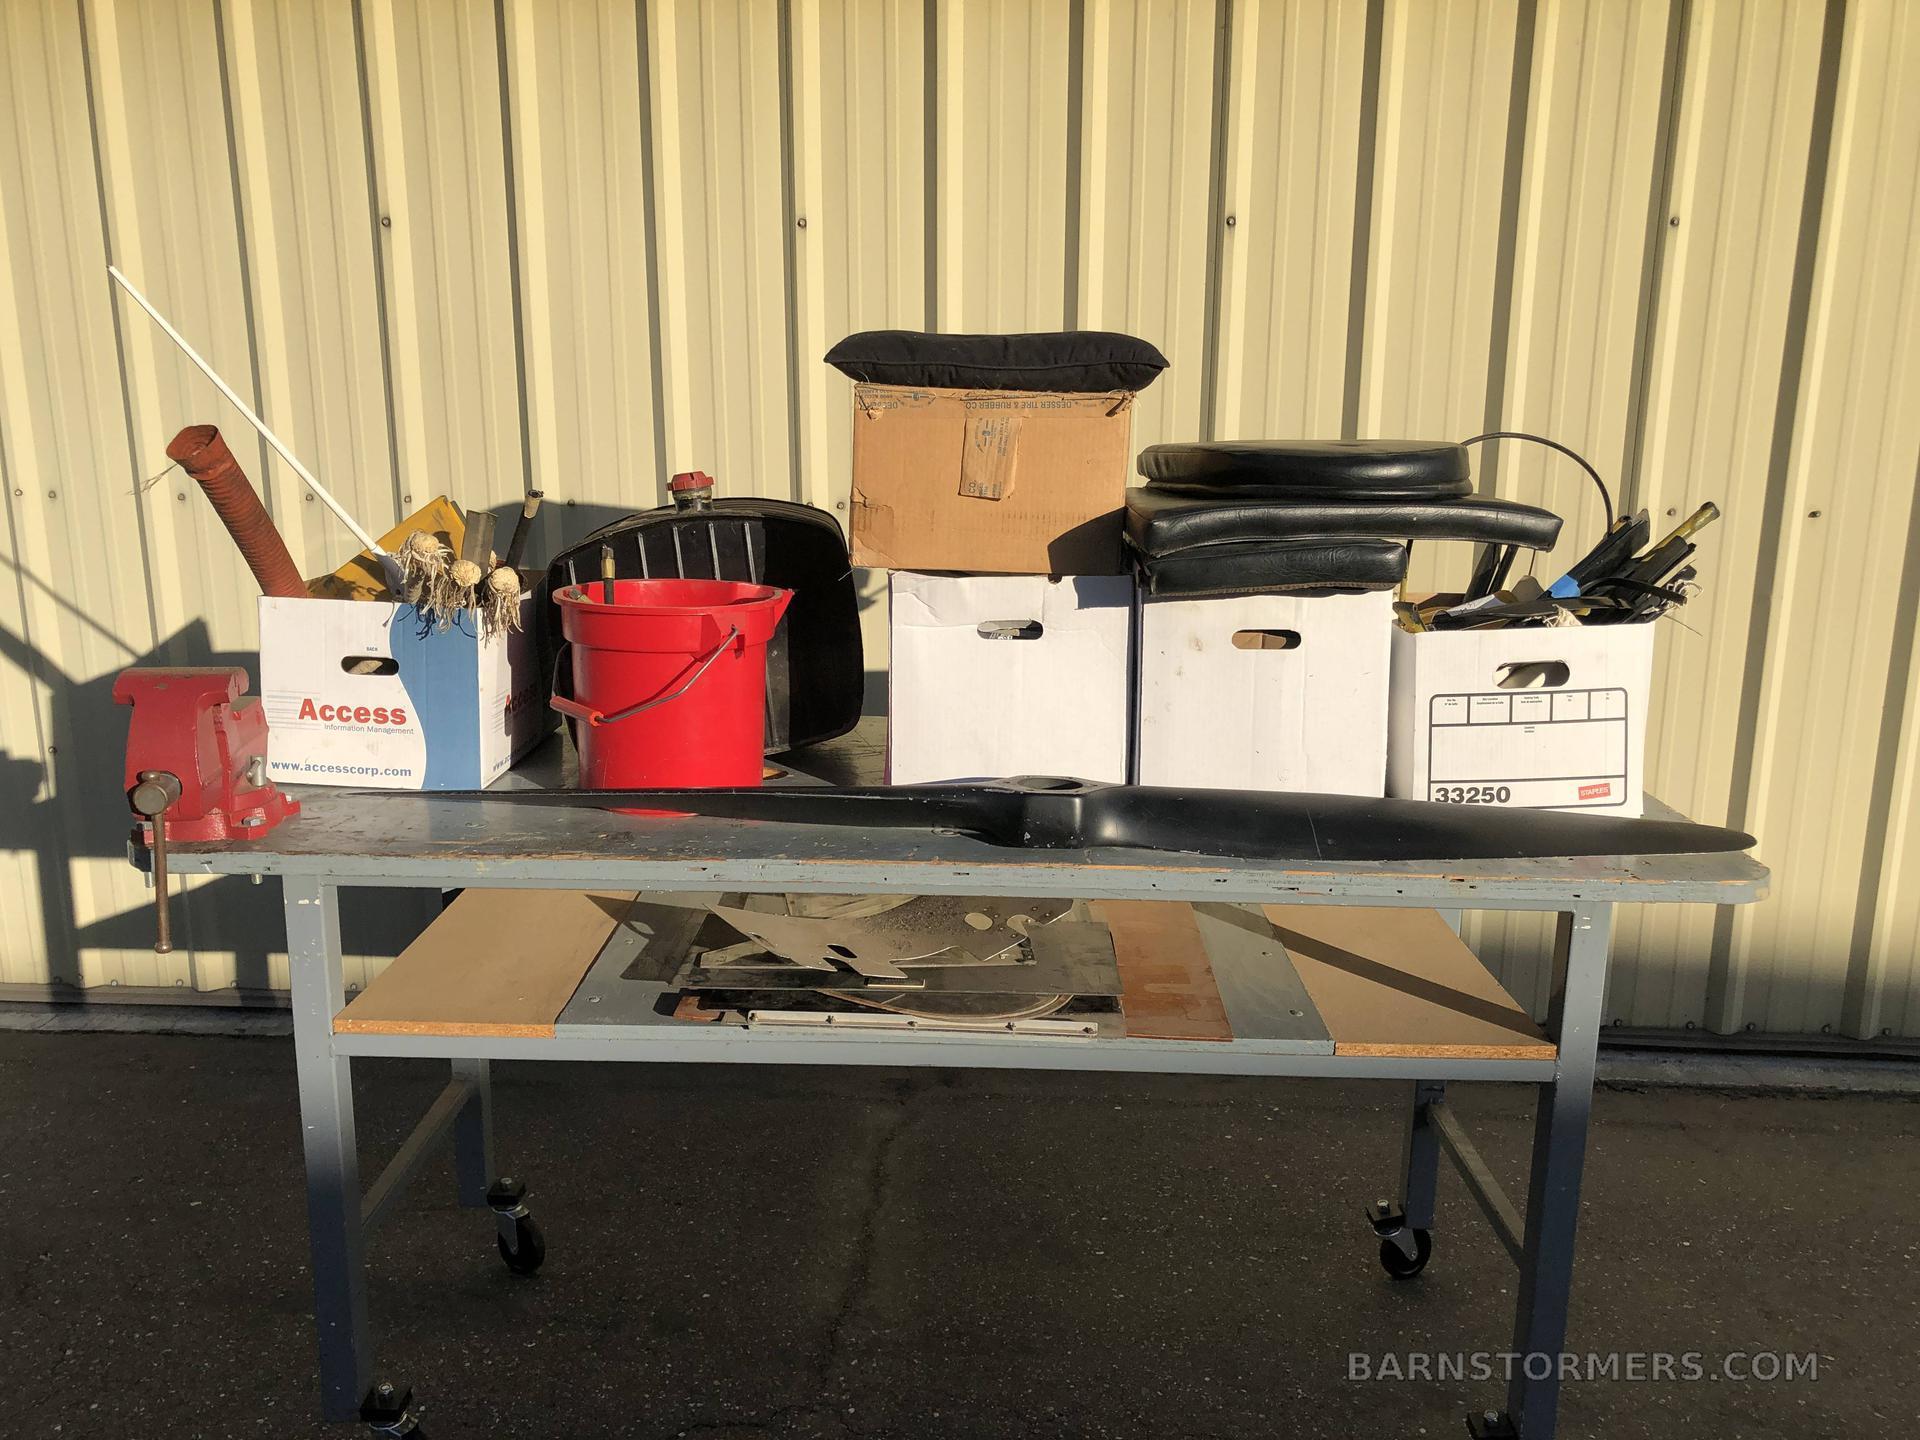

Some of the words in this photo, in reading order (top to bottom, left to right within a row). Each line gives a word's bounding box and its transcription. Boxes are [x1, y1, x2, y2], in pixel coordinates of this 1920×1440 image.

[964, 401, 978, 409] CO.
[980, 401, 1012, 409] RUBBER
[1021, 401, 1039, 409] TIRE
[1041, 401, 1072, 409] DESSER
[298, 698, 407, 725] Access
[324, 723, 365, 733] Information
[367, 725, 414, 736] Management
[271, 760, 412, 777] www.accesscorp.com
[1434, 786, 1511, 804] 33250
[1579, 786, 1610, 797] STAPLES
